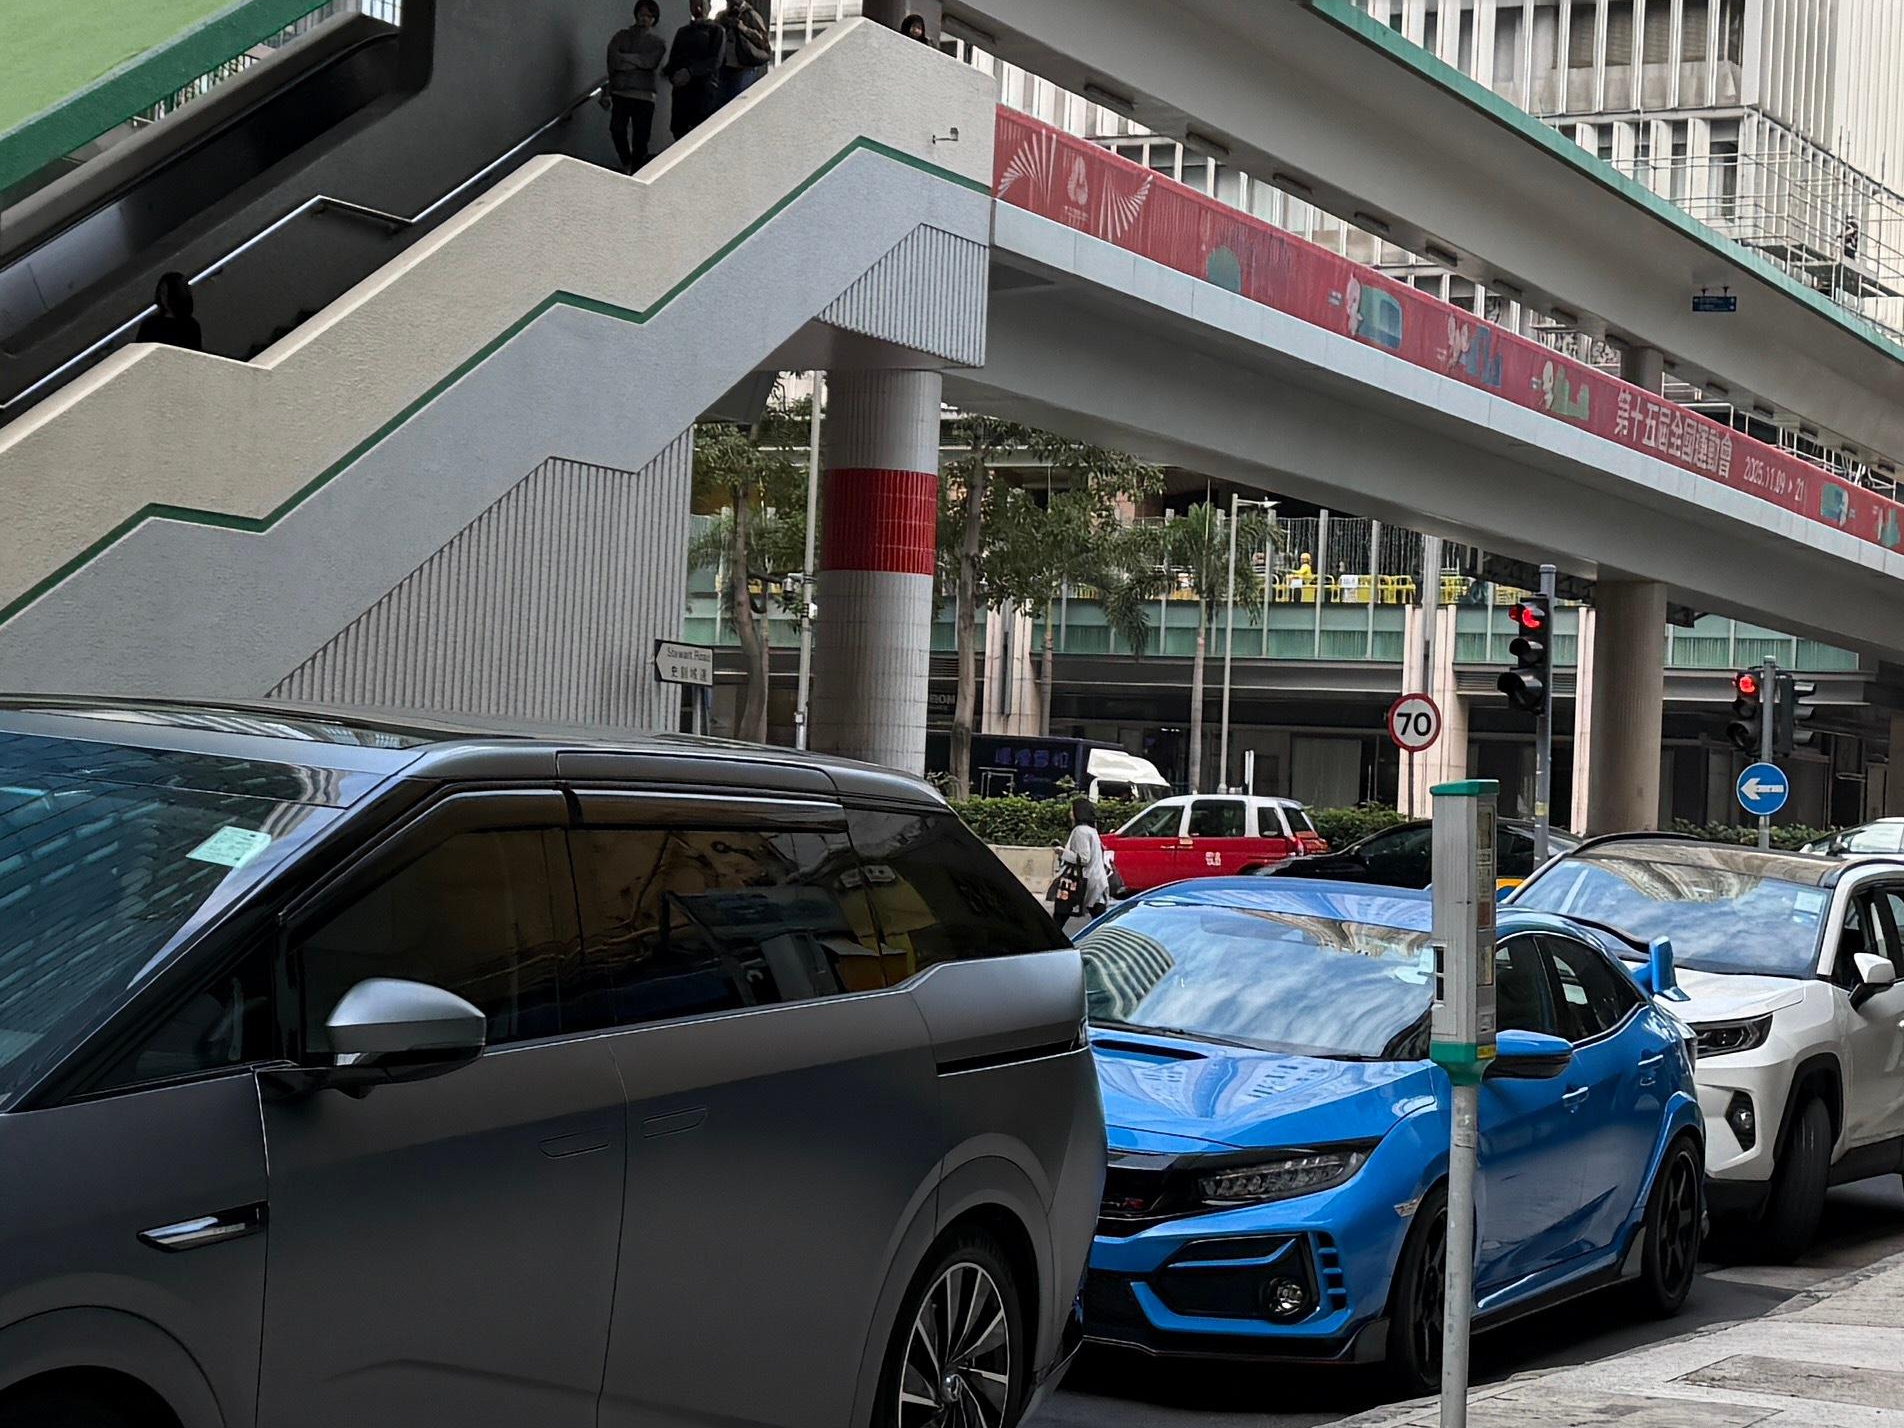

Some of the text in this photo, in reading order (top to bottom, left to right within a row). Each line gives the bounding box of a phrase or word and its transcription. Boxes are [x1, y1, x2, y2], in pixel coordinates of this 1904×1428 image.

[1614, 387, 1733, 479] 第十五屆全國運動會
[1396, 712, 1432, 736] 70
